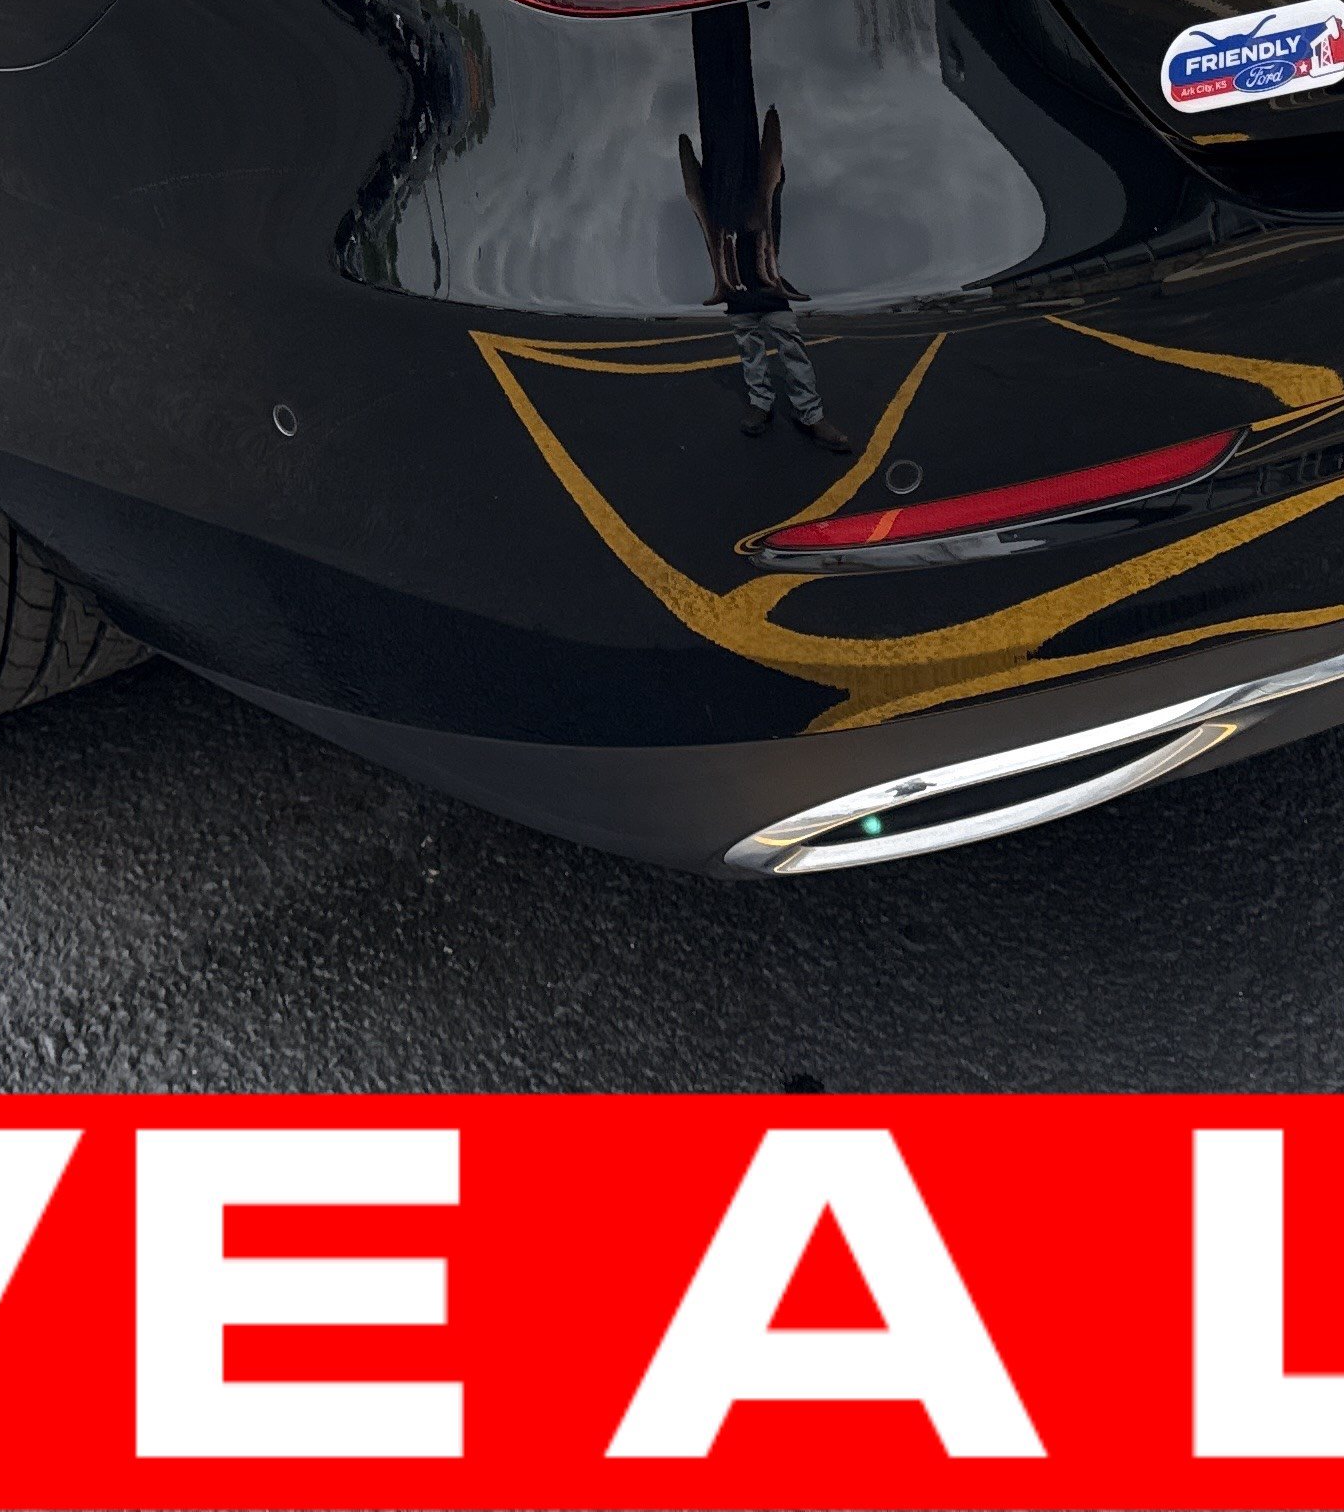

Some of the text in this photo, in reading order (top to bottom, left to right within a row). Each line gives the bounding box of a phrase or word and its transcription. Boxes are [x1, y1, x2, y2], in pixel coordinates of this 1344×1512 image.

[1185, 34, 1303, 76] FRIENDLY
[1245, 64, 1284, 88] Ford
[1180, 87, 1196, 97] Ark
